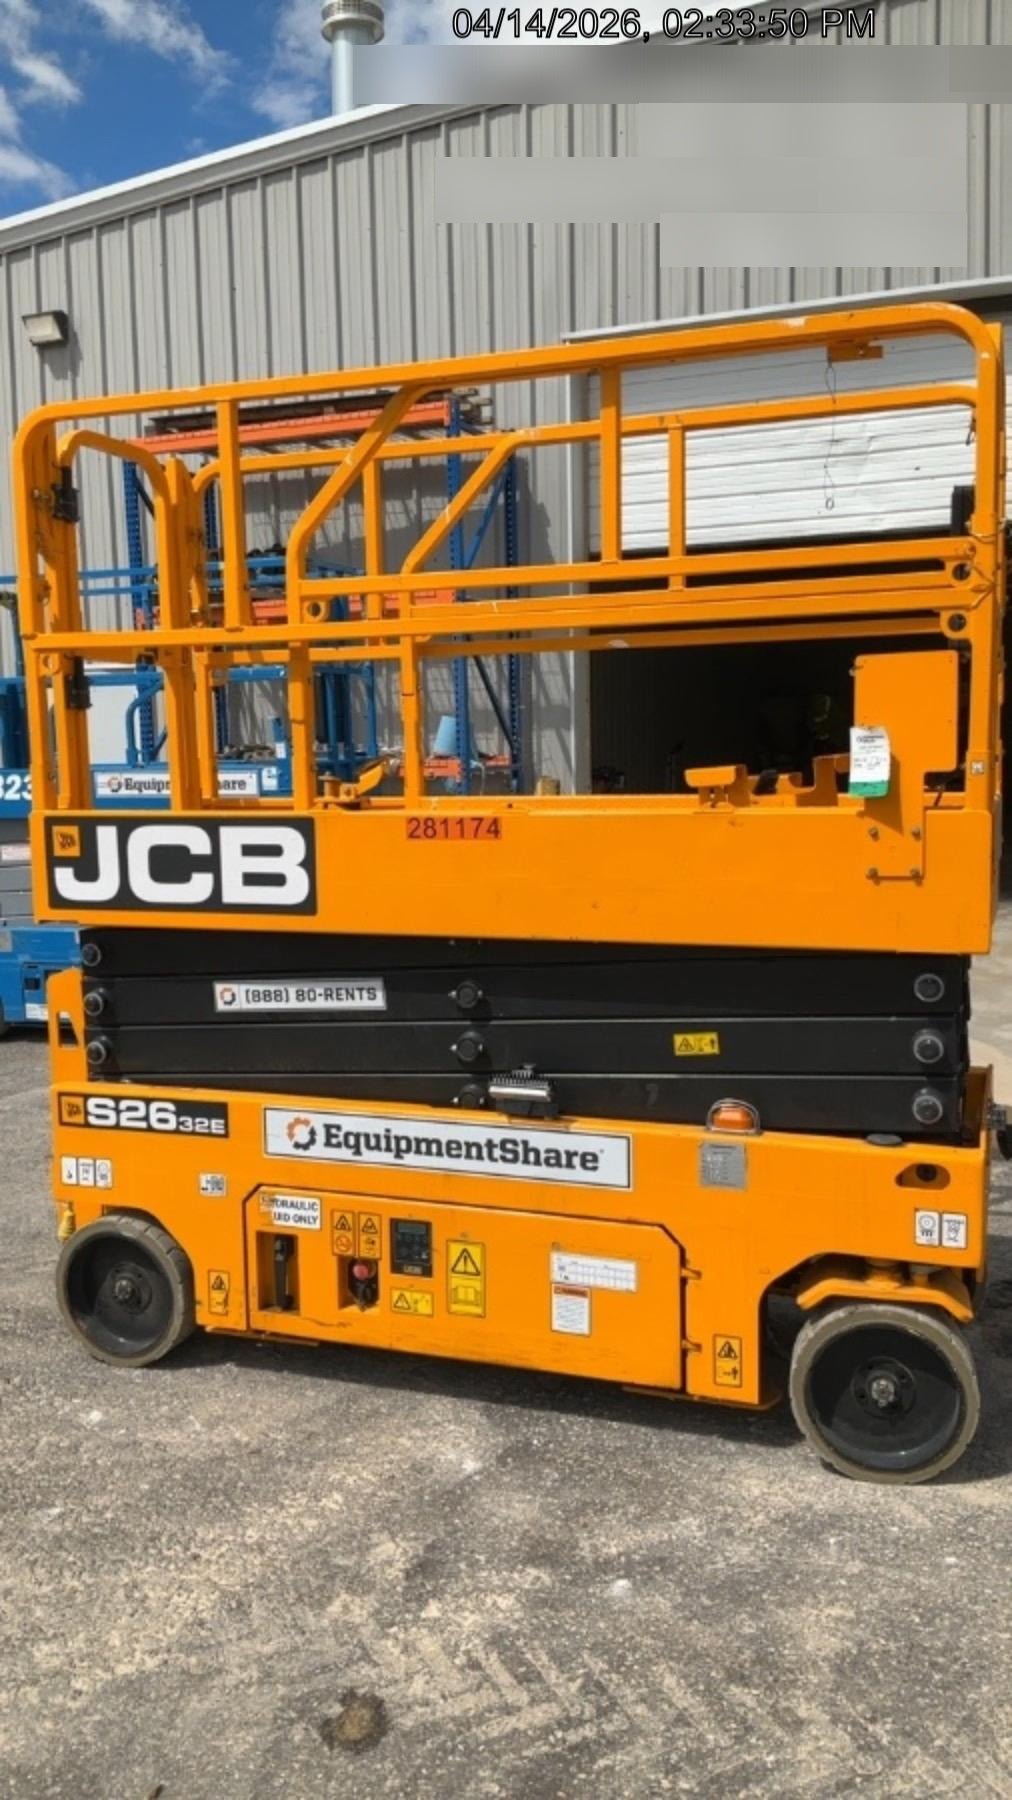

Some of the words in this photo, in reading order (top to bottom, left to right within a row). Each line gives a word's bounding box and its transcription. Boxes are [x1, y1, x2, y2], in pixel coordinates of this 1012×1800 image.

[407, 817, 500, 839] 281174
[54, 825, 310, 905] JCB
[245, 988, 289, 1004] (888)
[295, 986, 377, 1003] 80-RENTS
[322, 1122, 599, 1172] EquipmentShare
[293, 1213, 319, 1225] ONLY
